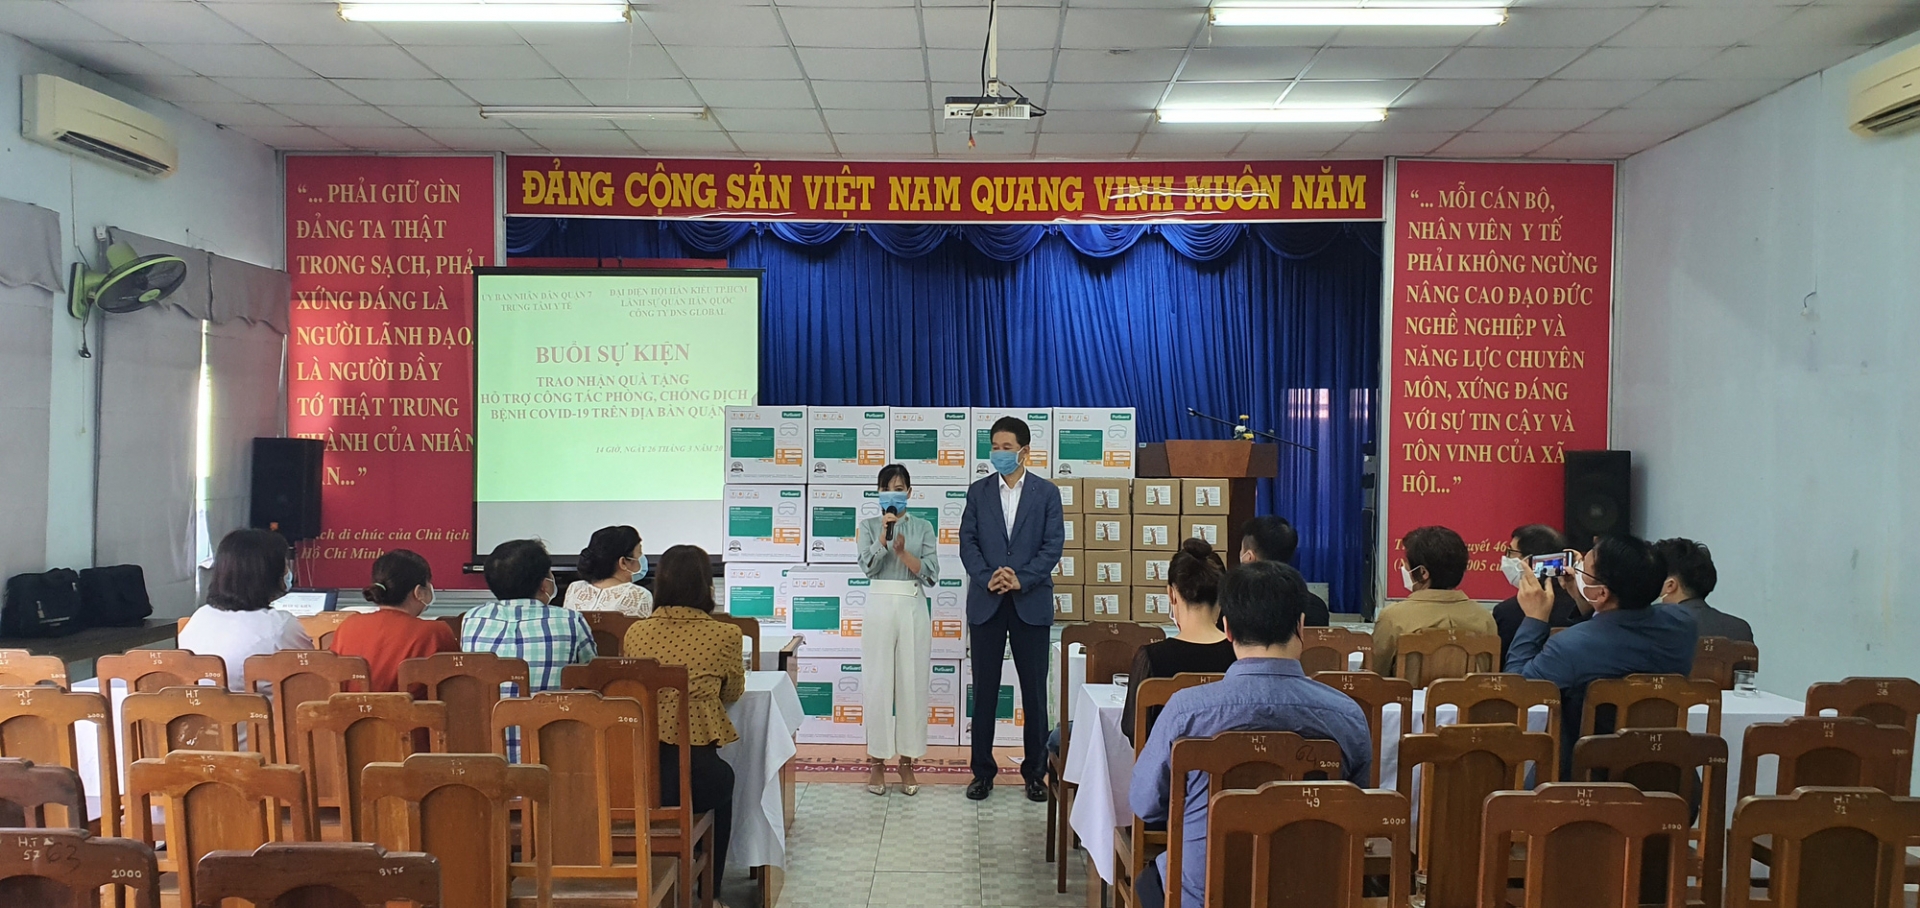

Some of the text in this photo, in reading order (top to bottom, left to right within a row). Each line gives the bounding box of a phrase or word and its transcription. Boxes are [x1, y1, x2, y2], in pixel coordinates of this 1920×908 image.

[328, 177, 377, 203] PHẢI
[382, 179, 419, 203] GIỮ
[424, 178, 461, 203] GÌN
[522, 158, 1366, 218] ĐẢNG CỘNG SẢN VIỆT NAM QUANG VINH MUÔN NĂM
[1439, 181, 1476, 208] MỖI
[1481, 186, 1519, 209] CÁN
[1525, 187, 1554, 212] BỘ,
[297, 213, 447, 242] ĐẢNG TA THẬT
[1408, 215, 1563, 241] NHÂN VIÊN Y TẾ
[297, 248, 485, 278] TRONG SẠCH, PHẢI
[1407, 247, 1597, 274] PHẢI KHÔNG NGỪNG
[297, 285, 448, 310] XỨNG ĐÁNG LÀ
[1406, 280, 1592, 308] NÂNG CAO ĐẠO ĐỨC
[690, 308, 726, 316] GLOBAL
[1405, 308, 1566, 339] NGHỀ NGHIỆP VÀ
[297, 321, 361, 345] NGƯỜI
[367, 322, 422, 345] LÃNH
[297, 352, 442, 380] LÀ NGƯỜI ĐẦY
[536, 341, 689, 366] BUỔI SỰ KIỆN
[1404, 345, 1584, 370] NĂNG LỰC CHUYÊN
[536, 376, 574, 387] TRAO
[577, 374, 614, 389] NHẬN
[618, 372, 647, 388] QUÀ
[1403, 375, 1568, 401] MÔN, XỨNG ĐÁNG
[297, 392, 459, 419] TỚ THẬT TRUNG
[503, 392, 531, 406] TRỢ
[534, 390, 572, 403] CÔNG
[575, 390, 602, 402] TÁC
[606, 389, 657, 402] PHÒNG,
[713, 390, 748, 403] DỊCH
[491, 408, 526, 422] BỆNH
[529, 409, 589, 419] COVID-19
[591, 404, 627, 418] TRÊN
[631, 407, 654, 420] ĐỊA
[658, 404, 685, 417] BÀN
[1403, 407, 1575, 434] VỚI SỰ TIN CẬY VÀ
[298, 427, 368, 451] ÀNH
[374, 426, 415, 452] CỦA
[1402, 438, 1565, 463] TÔN VINH CỦA XÃ
[339, 529, 351, 539] di
[354, 529, 384, 539] chúc
[389, 528, 411, 540] của
[416, 528, 442, 539] Chủ
[446, 529, 469, 542] tịch
[1467, 538, 1490, 554] uyết
[301, 546, 320, 558] Hồ
[324, 548, 346, 558] Chí
[1467, 560, 1487, 571] 005
[186, 690, 199, 698] H.T
[1302, 788, 1319, 797] H.T
[1306, 798, 1320, 808] 49
[1577, 789, 1593, 798] H.T
[18, 837, 38, 847] H.T
[23, 850, 40, 861] 57
[111, 870, 142, 878] 2000
